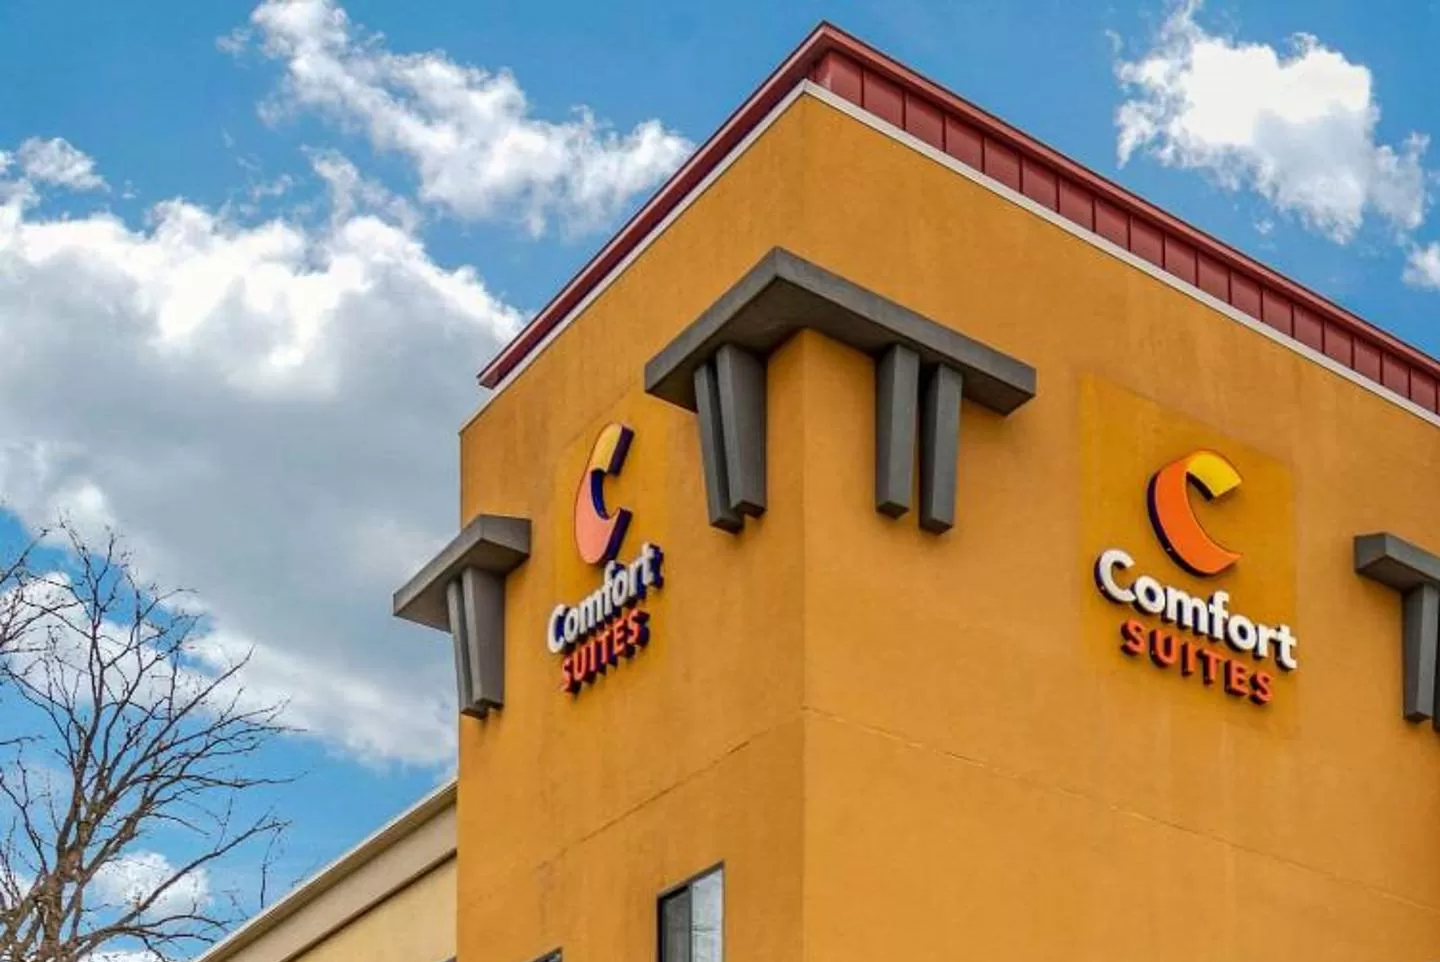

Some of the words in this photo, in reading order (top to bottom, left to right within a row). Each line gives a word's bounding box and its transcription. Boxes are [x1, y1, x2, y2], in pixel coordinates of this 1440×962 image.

[548, 542, 663, 653] Comfort
[1094, 549, 1297, 670] Comfort
[560, 608, 650, 696] SUITES
[1121, 619, 1274, 703] SUITES
